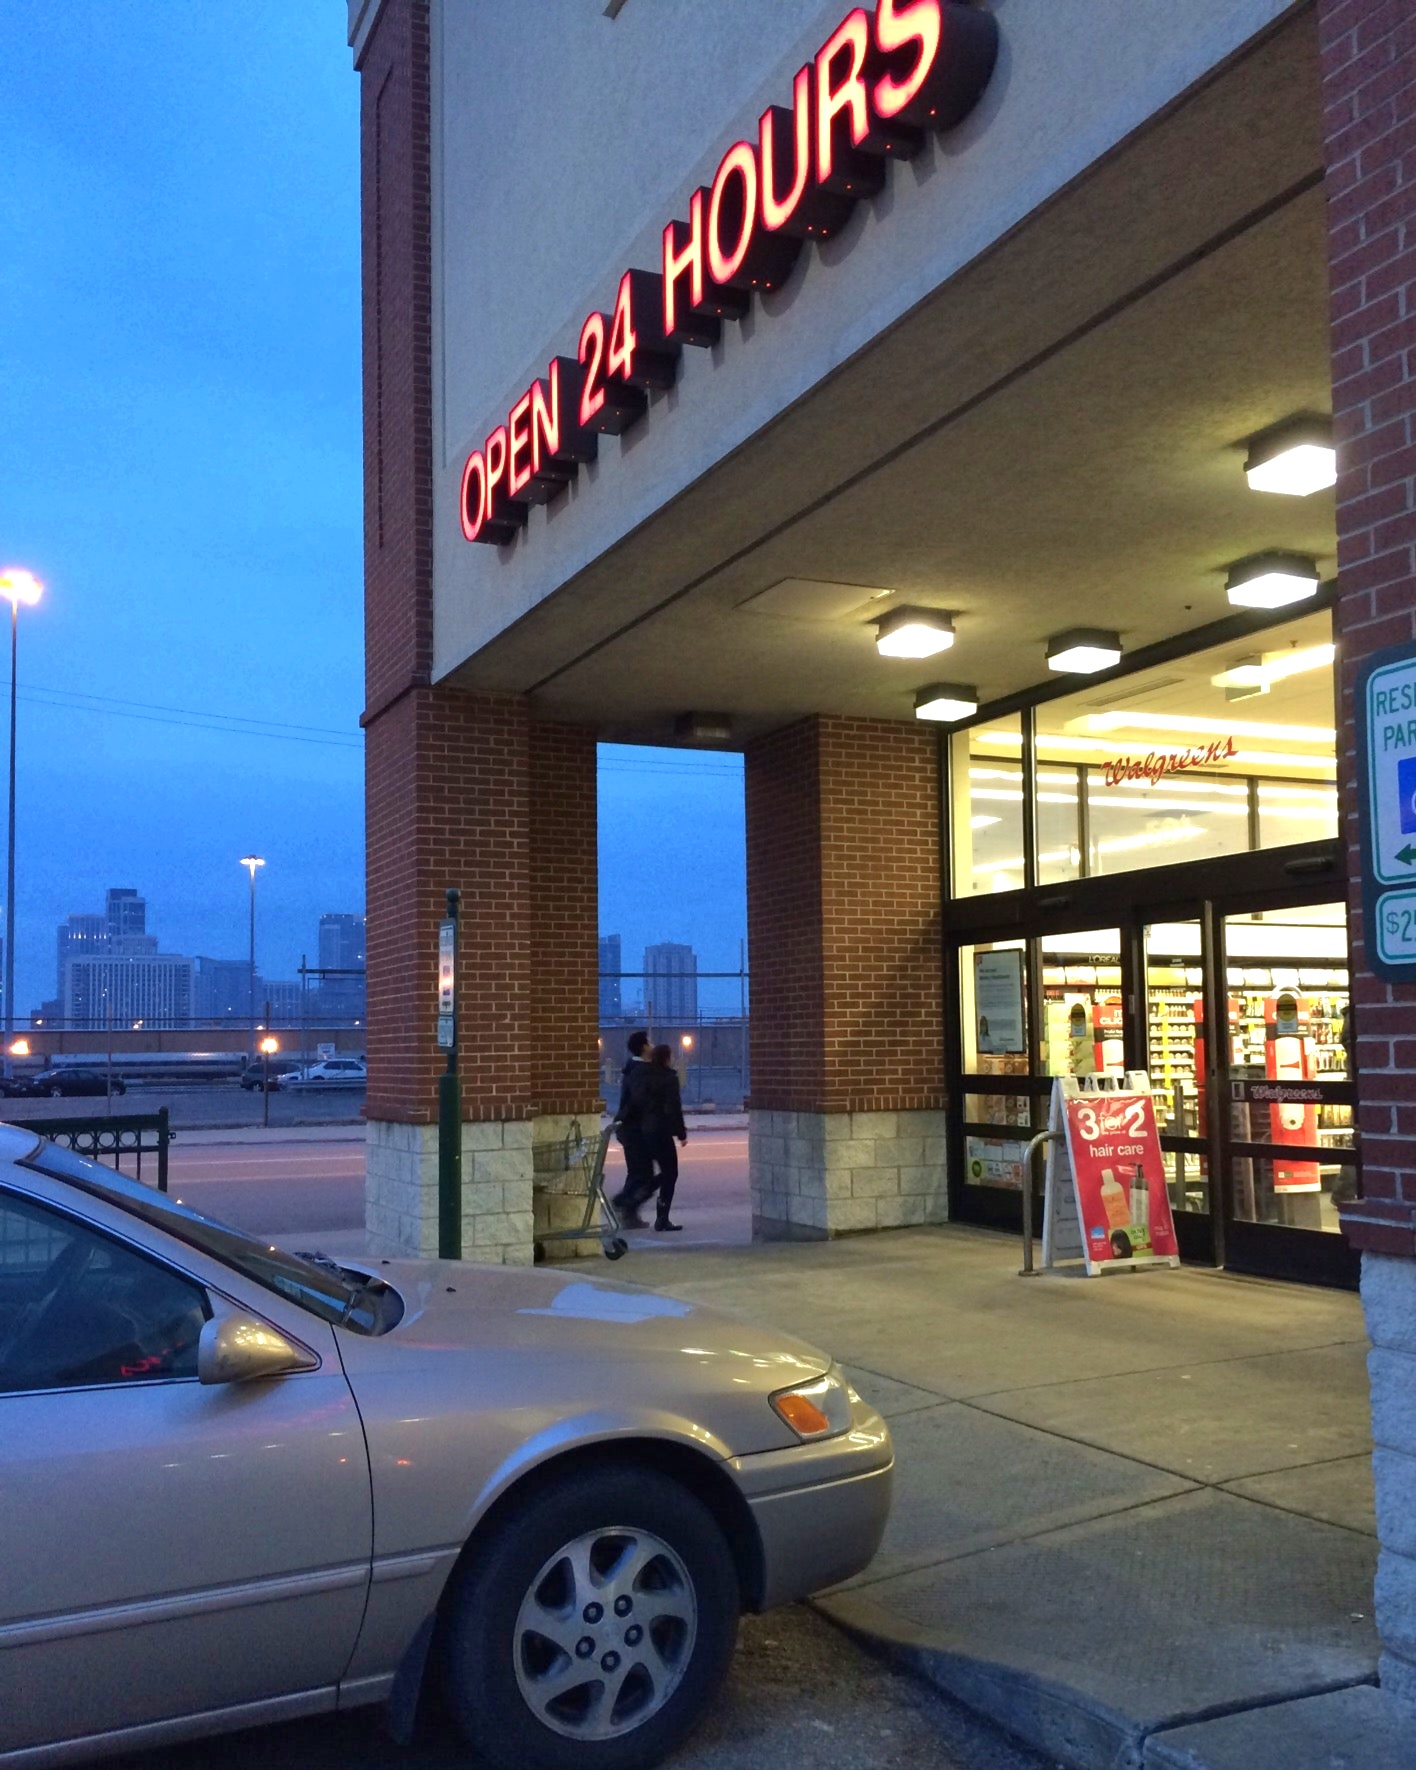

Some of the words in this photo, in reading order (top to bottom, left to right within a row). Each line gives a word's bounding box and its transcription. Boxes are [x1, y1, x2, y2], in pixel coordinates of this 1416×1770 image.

[459, 358, 561, 542] OPEN
[578, 270, 636, 427] 24
[662, 0, 942, 338] HOURS
[1376, 682, 1416, 717] RES
[1101, 735, 1239, 787] Walgreens
[1386, 909, 1416, 942] $2
[1250, 1085, 1323, 1103] Walgreens
[1077, 1107, 1100, 1141] 3
[1124, 1104, 1148, 1138] 2
[1089, 1143, 1114, 1158] hair
[1117, 1144, 1144, 1156] care
